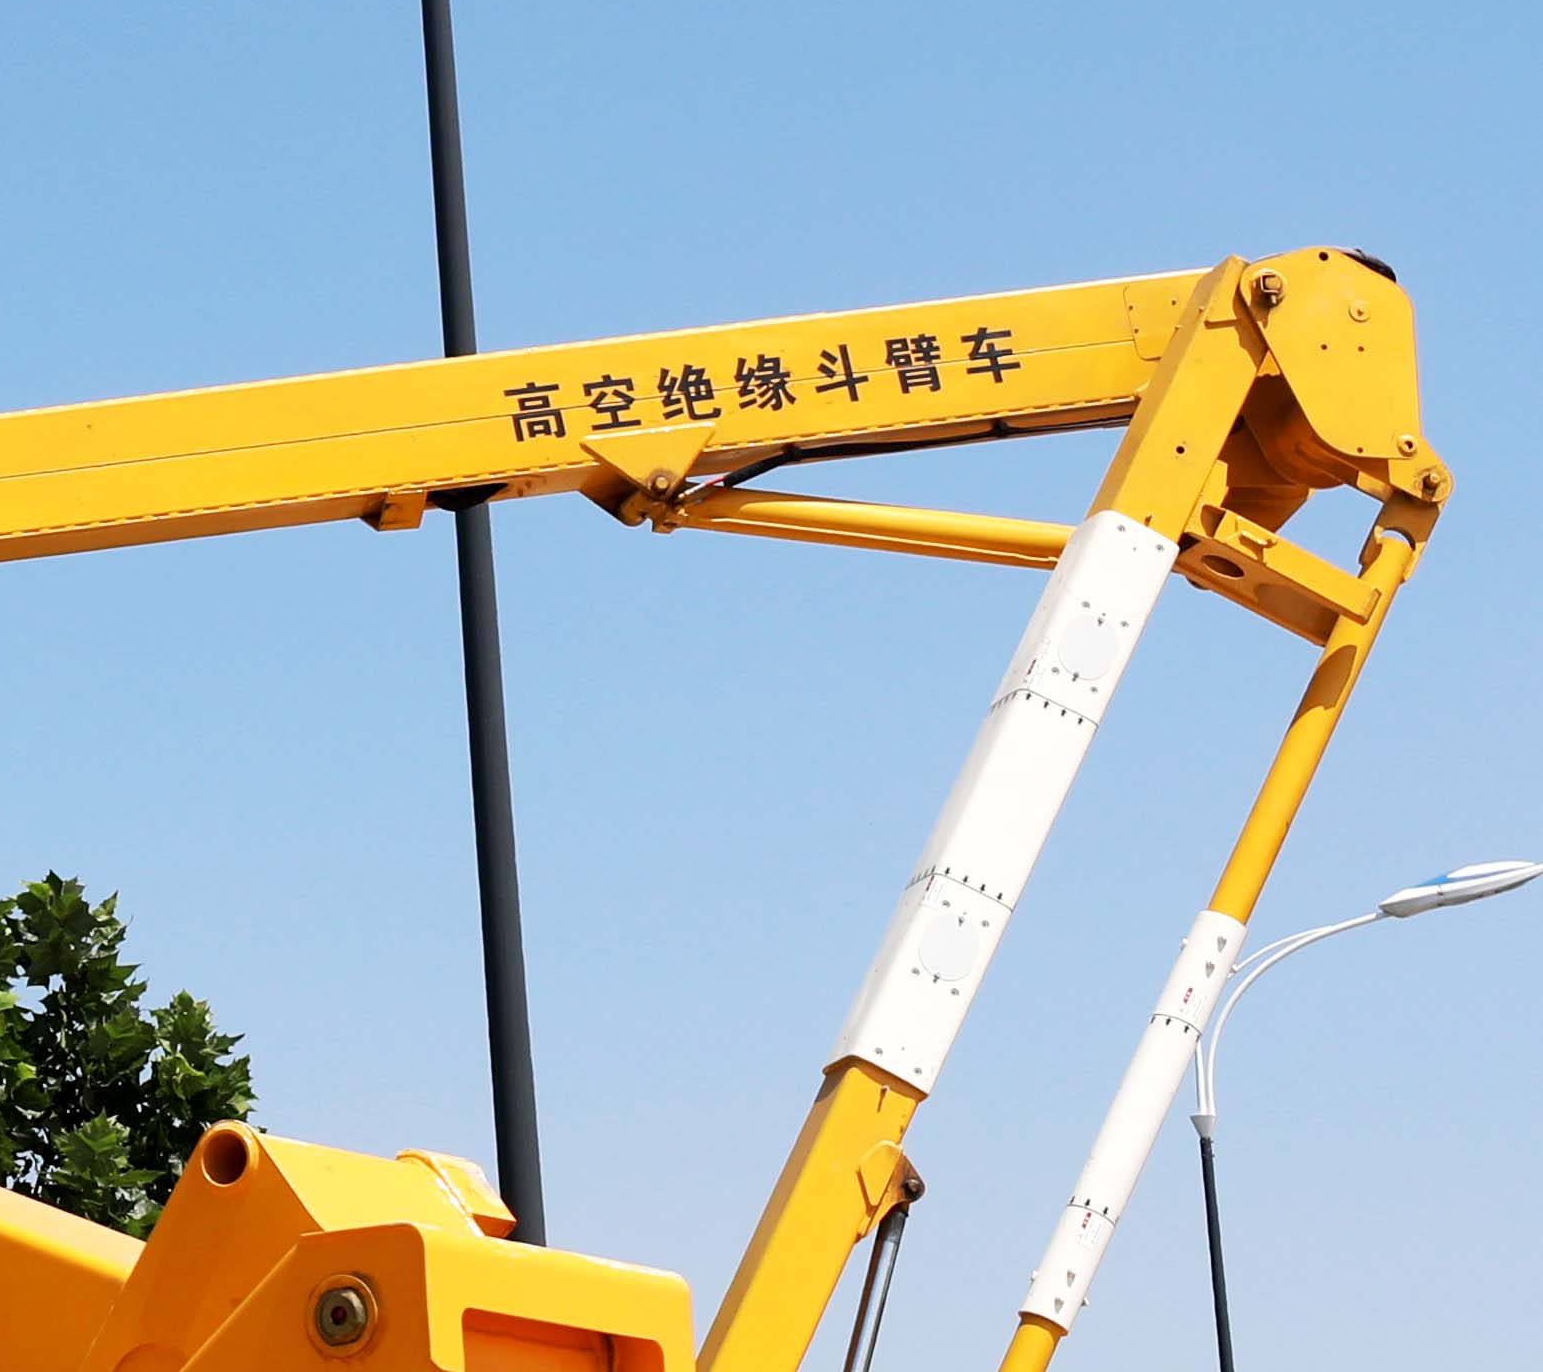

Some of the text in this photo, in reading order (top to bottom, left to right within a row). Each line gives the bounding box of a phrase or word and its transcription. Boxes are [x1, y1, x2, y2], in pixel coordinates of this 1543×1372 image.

[503, 327, 1021, 442] 高空绝缘斗臂车
